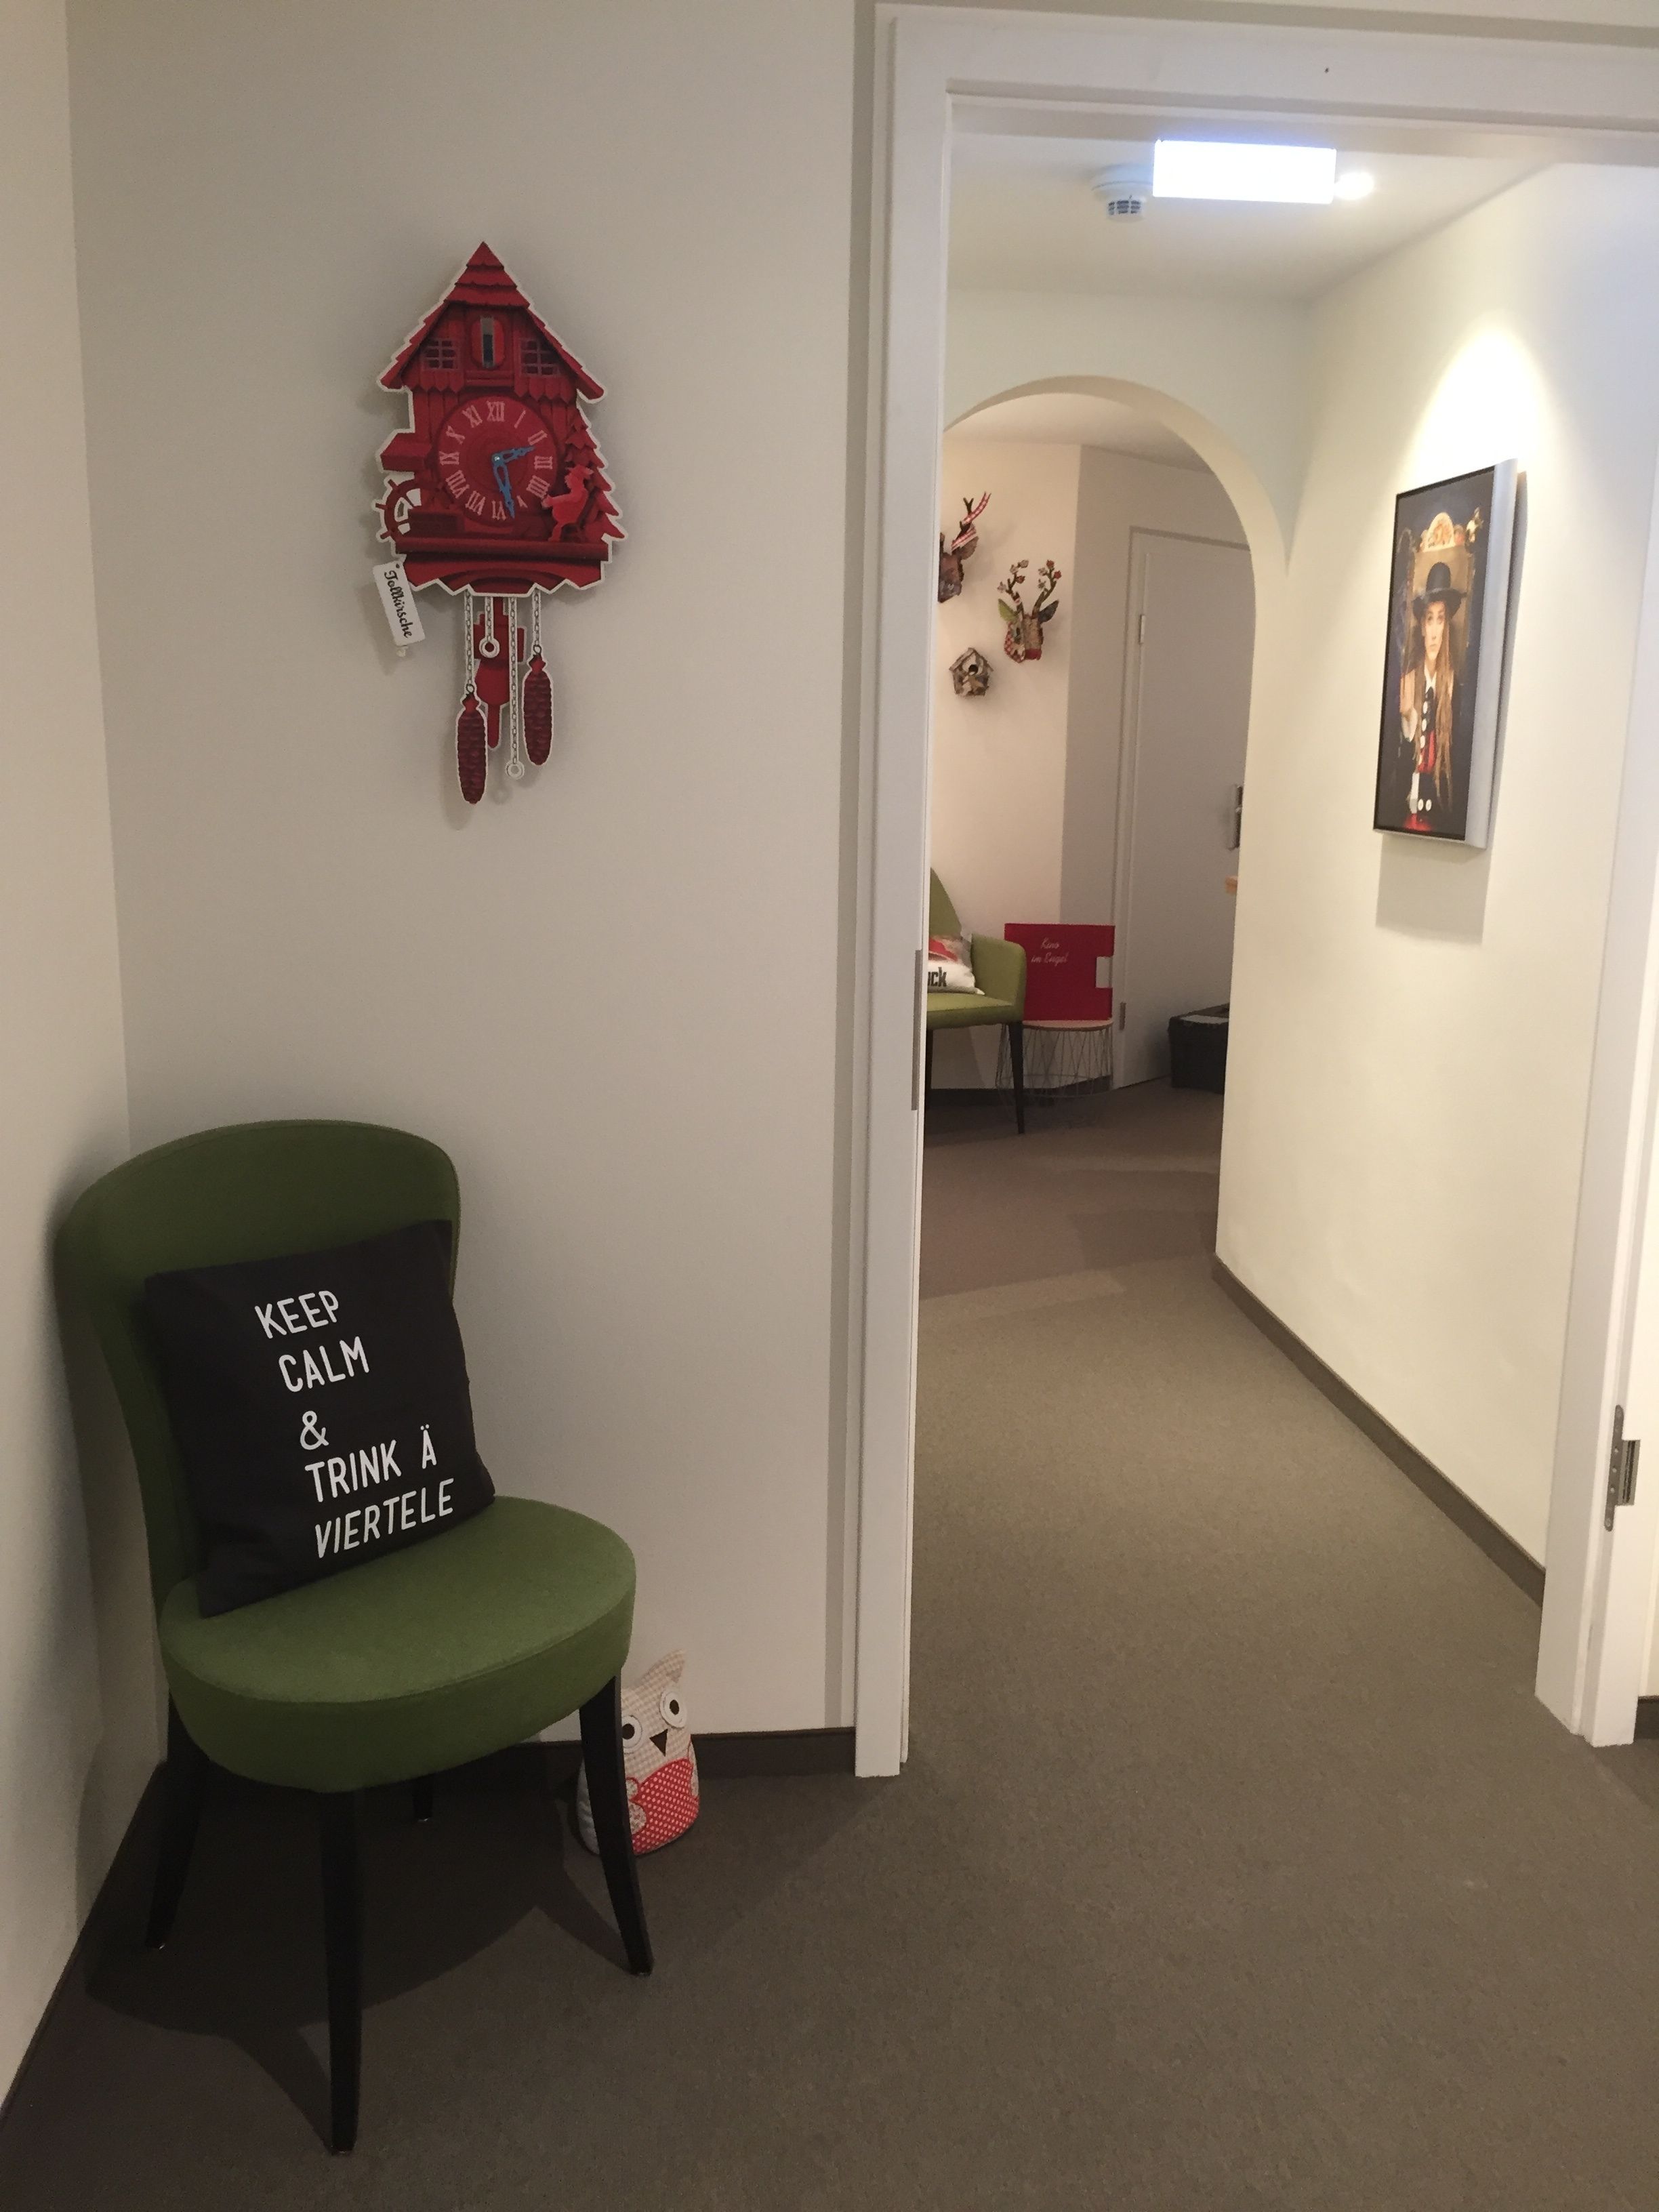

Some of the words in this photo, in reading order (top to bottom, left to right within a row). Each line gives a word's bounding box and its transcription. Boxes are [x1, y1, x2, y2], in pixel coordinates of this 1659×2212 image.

[486, 401, 506, 422] XII
[384, 570, 414, 638] Tollkirsche
[254, 1290, 339, 1339] KEEP
[278, 1336, 370, 1393] CALM
[300, 1410, 329, 1450] &
[304, 1439, 402, 1502] TRINK
[420, 1424, 437, 1469] Ä
[314, 1478, 454, 1559] VIERTELE
